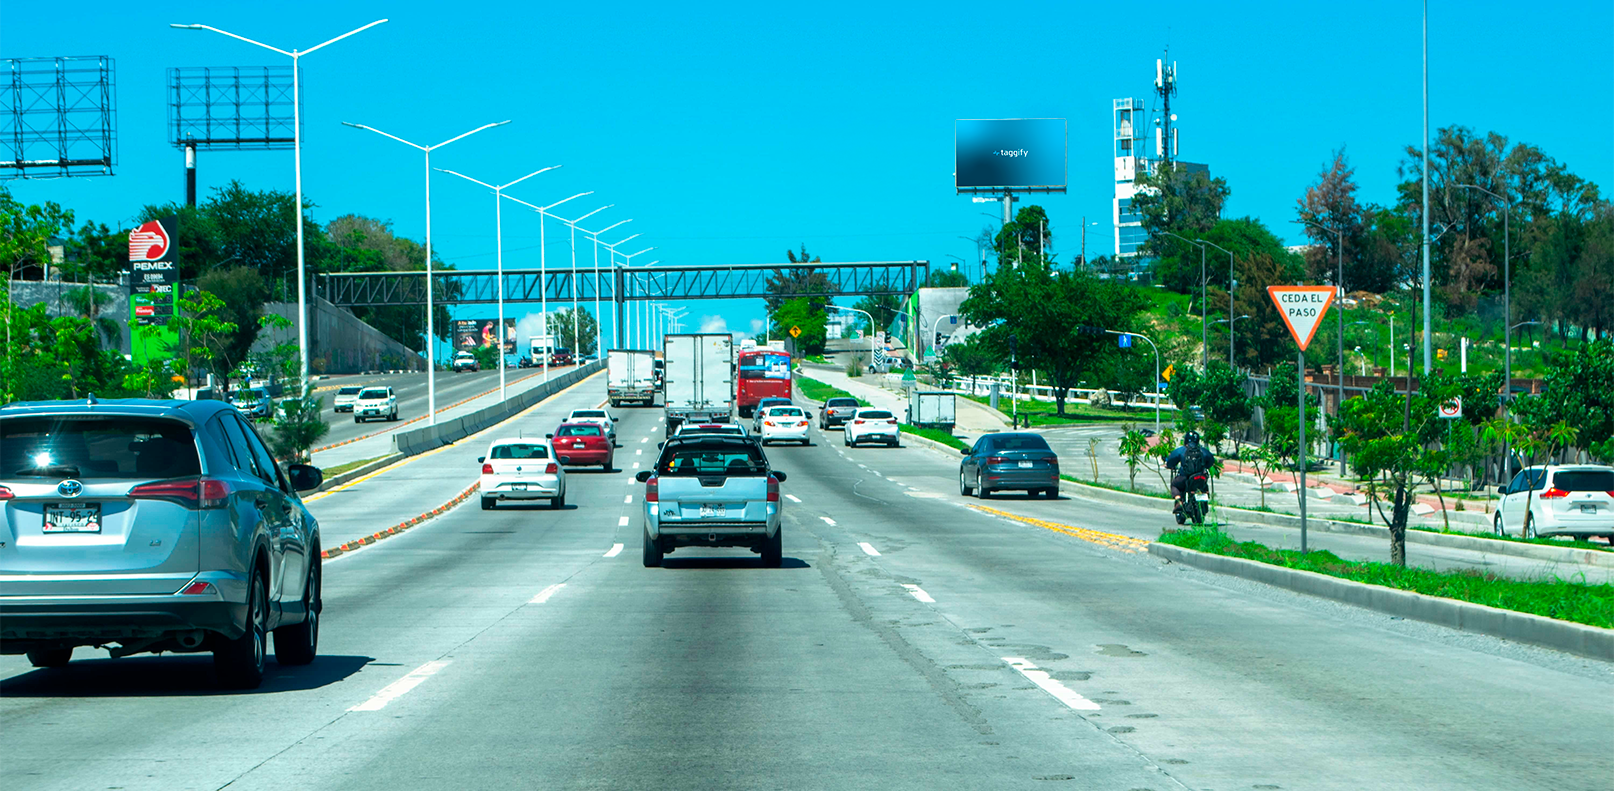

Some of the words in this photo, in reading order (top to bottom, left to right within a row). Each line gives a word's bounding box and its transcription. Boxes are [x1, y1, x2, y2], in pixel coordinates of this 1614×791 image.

[1000, 149, 1029, 157] taggify
[133, 261, 173, 270] PEMEX
[1281, 294, 1308, 303] CEDA
[1311, 294, 1323, 303] EL
[1289, 308, 1317, 317] PASO
